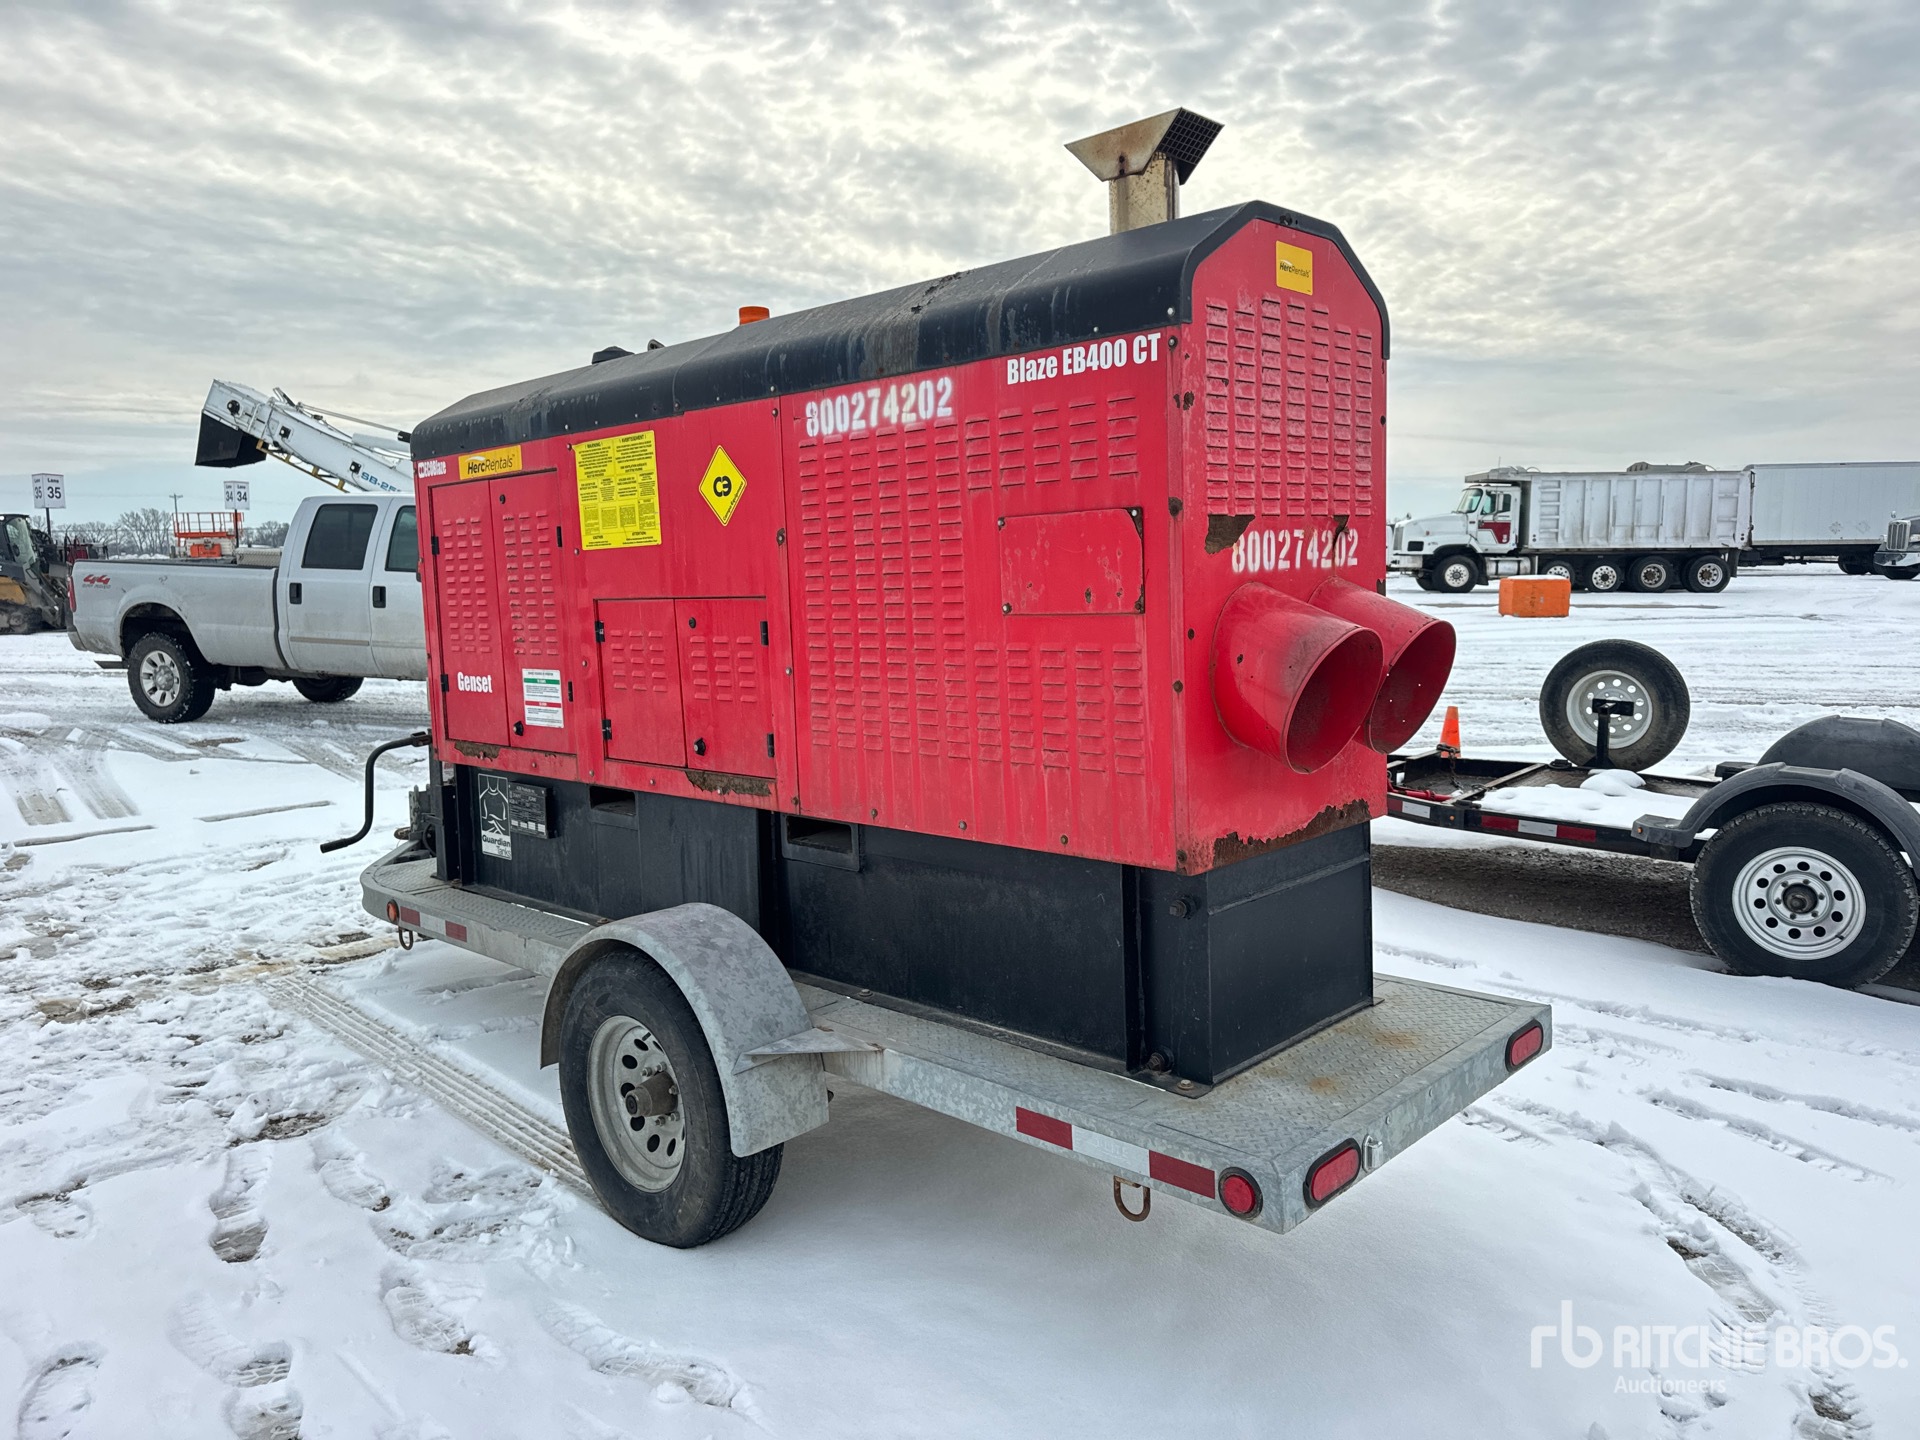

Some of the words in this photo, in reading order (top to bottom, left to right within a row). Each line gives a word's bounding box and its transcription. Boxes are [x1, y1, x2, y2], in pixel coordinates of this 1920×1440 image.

[1280, 261, 1310, 278] HercRentals
[1007, 354, 1058, 385] Blaze
[1062, 339, 1127, 375] EB400
[1132, 332, 1162, 364] CT
[805, 376, 954, 437] 800274202
[467, 455, 513, 475] HercRentals
[34, 486, 43, 499] 35
[47, 486, 62, 499] 35
[225, 491, 234, 502] 34
[236, 490, 248, 502] 34
[1231, 528, 1359, 573] 800274202
[457, 671, 493, 693] Genset
[482, 834, 511, 848] Guardian
[496, 844, 512, 857] Tanks
